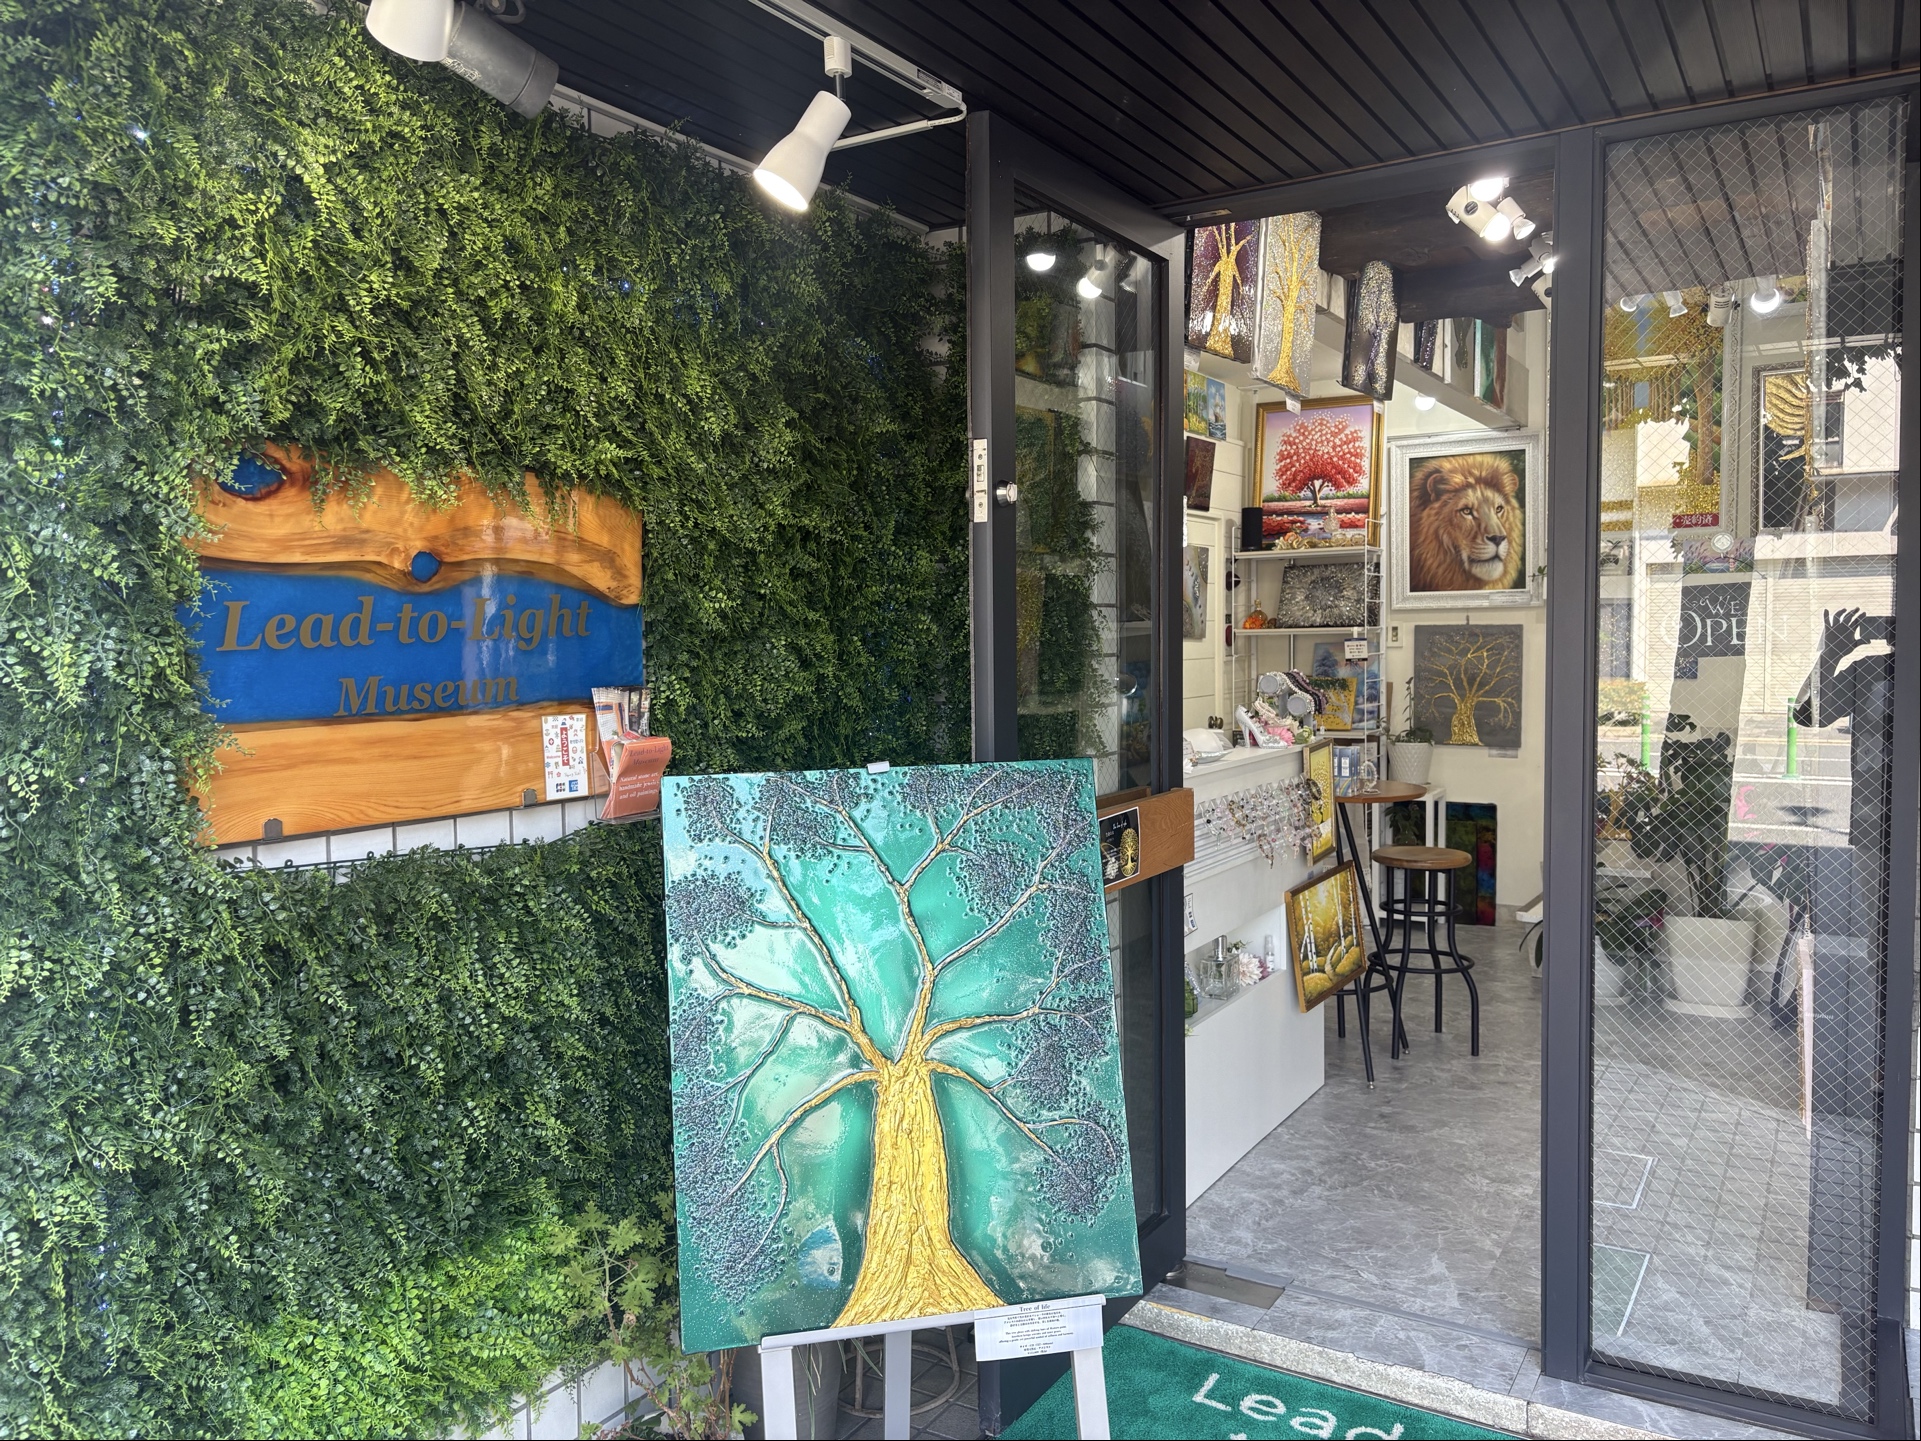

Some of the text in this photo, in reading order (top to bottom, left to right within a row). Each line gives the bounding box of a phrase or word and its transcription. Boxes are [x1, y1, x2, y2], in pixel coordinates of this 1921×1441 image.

[216, 594, 593, 652] Lead-to-Light
[333, 674, 519, 716] Museum
[561, 730, 569, 763] ようこそ
